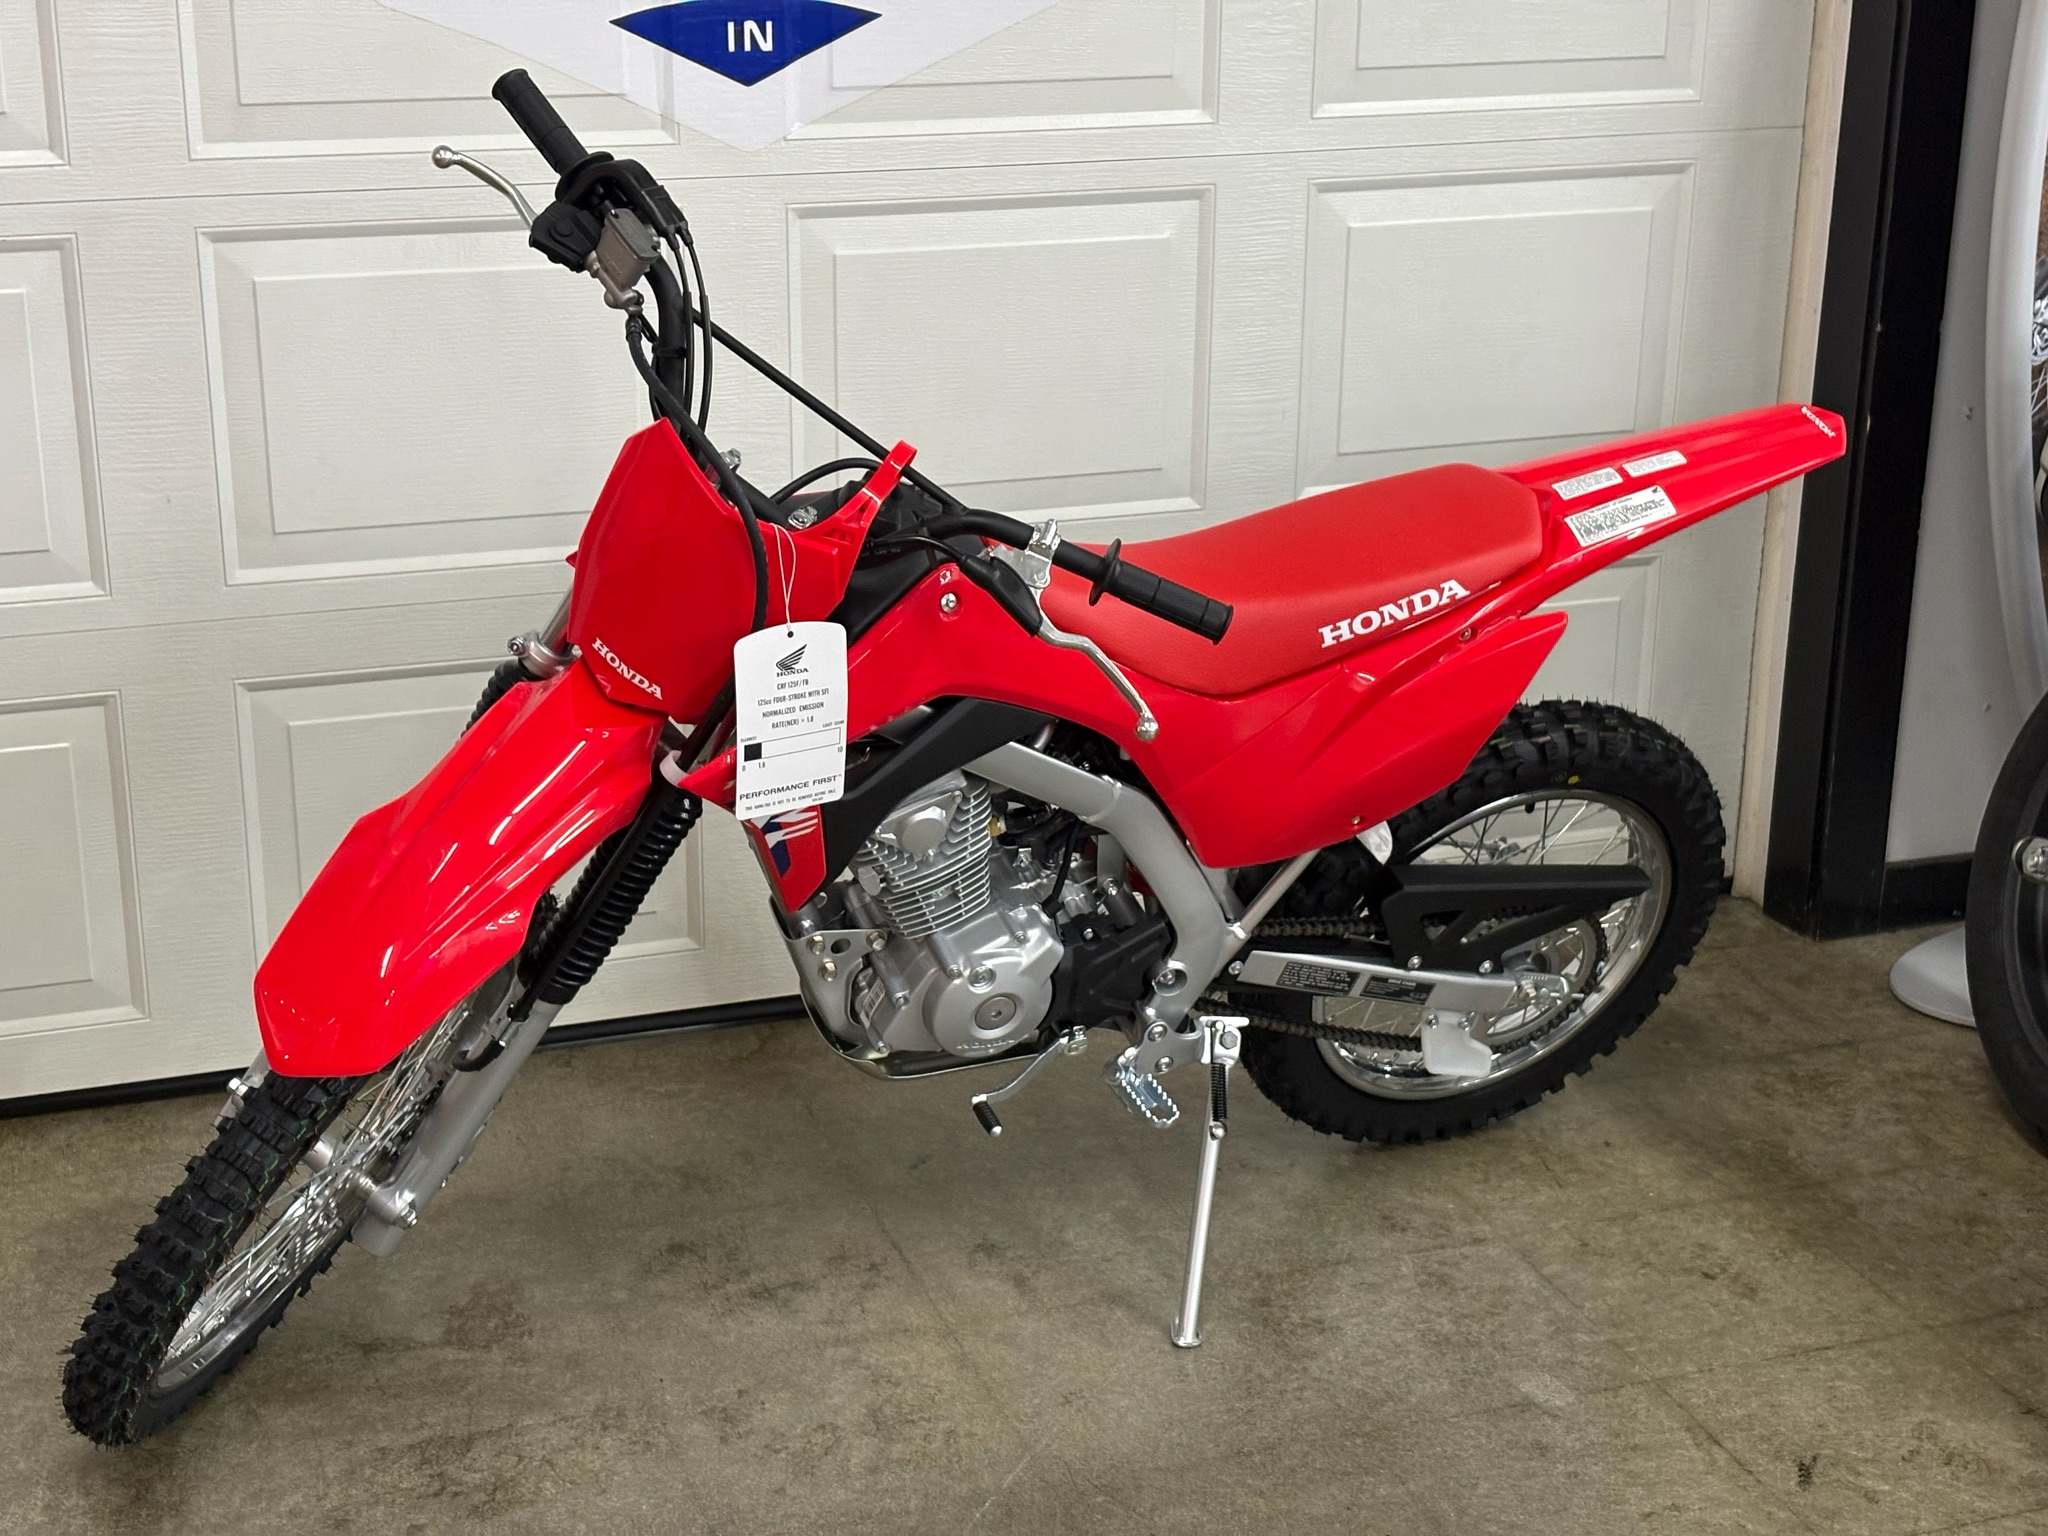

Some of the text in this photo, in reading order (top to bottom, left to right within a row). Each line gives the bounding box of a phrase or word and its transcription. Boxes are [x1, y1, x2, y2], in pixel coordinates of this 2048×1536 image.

[727, 20, 773, 53] IN
[1318, 578, 1470, 649] HONDA
[591, 636, 663, 700] HONDA
[776, 668, 809, 677] HONDA
[773, 692, 806, 704] FOUR-STROKE
[808, 689, 820, 697] WITH
[762, 701, 824, 718] NORMALIZED EMISSION
[771, 718, 799, 729] RATE(NER)
[739, 781, 810, 801] PERFORMANCE
